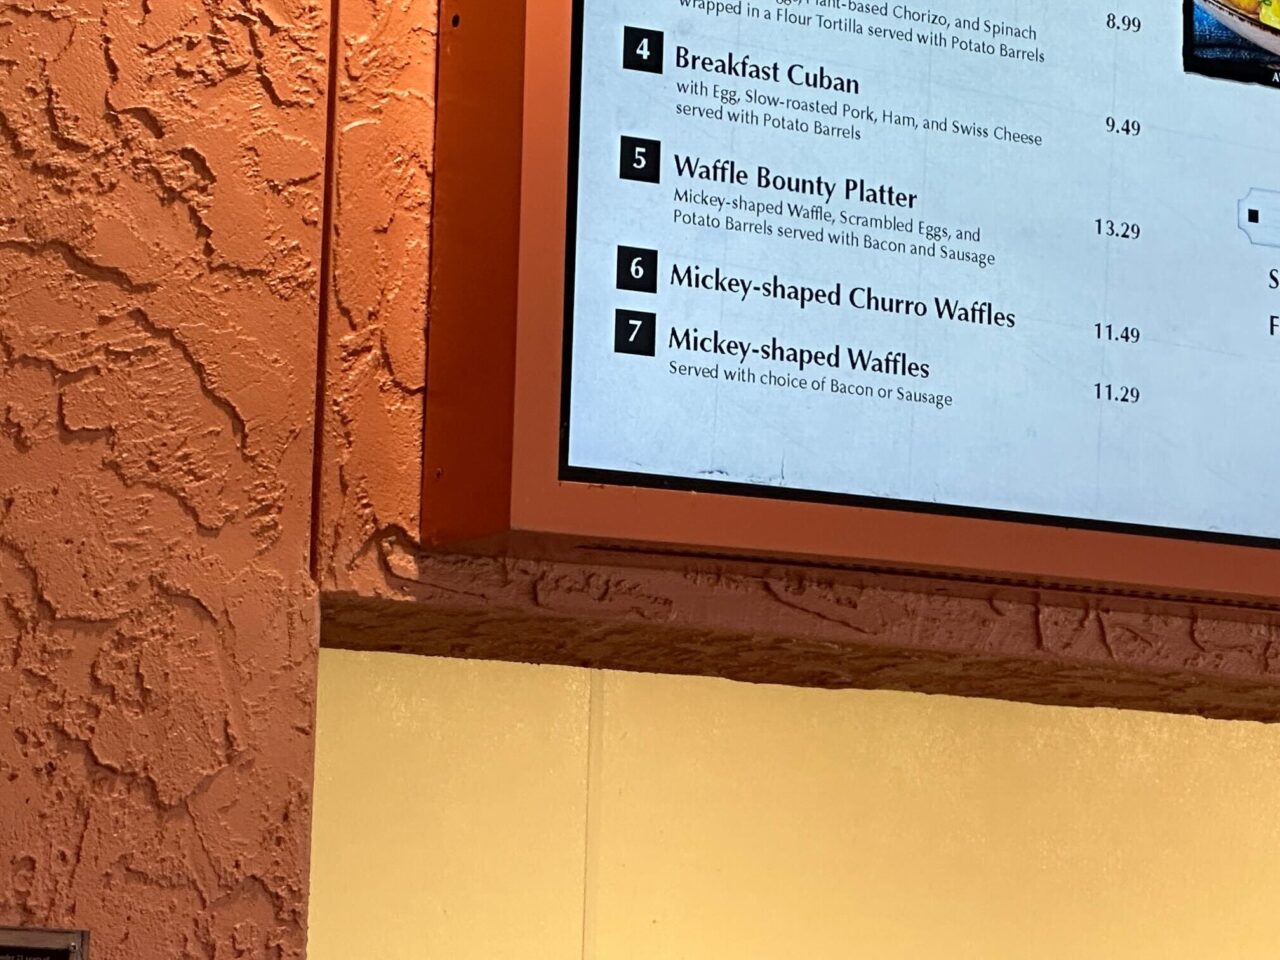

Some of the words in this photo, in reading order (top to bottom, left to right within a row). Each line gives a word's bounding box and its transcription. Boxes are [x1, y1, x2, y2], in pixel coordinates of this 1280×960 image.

[892, 4, 951, 30] Chorizo,
[954, 16, 980, 32] and
[983, 19, 1037, 41] Spinach
[1106, 12, 1141, 33] 8.99
[636, 38, 650, 60] 4
[676, 45, 780, 83] Breakfast
[787, 63, 859, 95] Cuban
[676, 80, 708, 97] with
[713, 84, 741, 106] Egg,
[745, 89, 838, 116] Slow-roasted
[842, 103, 878, 125] Pork,
[882, 109, 919, 131] Ham,
[922, 117, 947, 132] and
[952, 120, 989, 138] Swiss
[993, 126, 1042, 146] Cheese
[1105, 116, 1141, 136] 9.49
[632, 146, 646, 169] 5
[674, 154, 748, 186] Waffle
[757, 166, 836, 205] Bounty
[845, 178, 918, 209] Platter
[673, 187, 783, 218] Mickey-shaped
[787, 202, 836, 225] Waffle,
[840, 210, 913, 233] Scrambled
[918, 220, 952, 242] Eggs,
[955, 227, 981, 242] and
[1095, 218, 1141, 240] 13.29
[630, 256, 644, 279] 6
[670, 263, 841, 310] Mickey-shaped
[849, 286, 927, 317] Churro
[934, 296, 1015, 328] Waffles
[628, 319, 642, 342] 7
[1094, 322, 1140, 344] 11.49
[668, 326, 840, 371] Mickey-shaped
[847, 347, 930, 379] Waffles
[669, 360, 719, 379] Served
[723, 367, 756, 384] with
[760, 369, 808, 390] choice
[811, 376, 827, 392] of
[830, 378, 874, 397] Bacon
[877, 387, 893, 399] or
[896, 386, 953, 410] Sausage
[1094, 382, 1140, 404] 11.29
